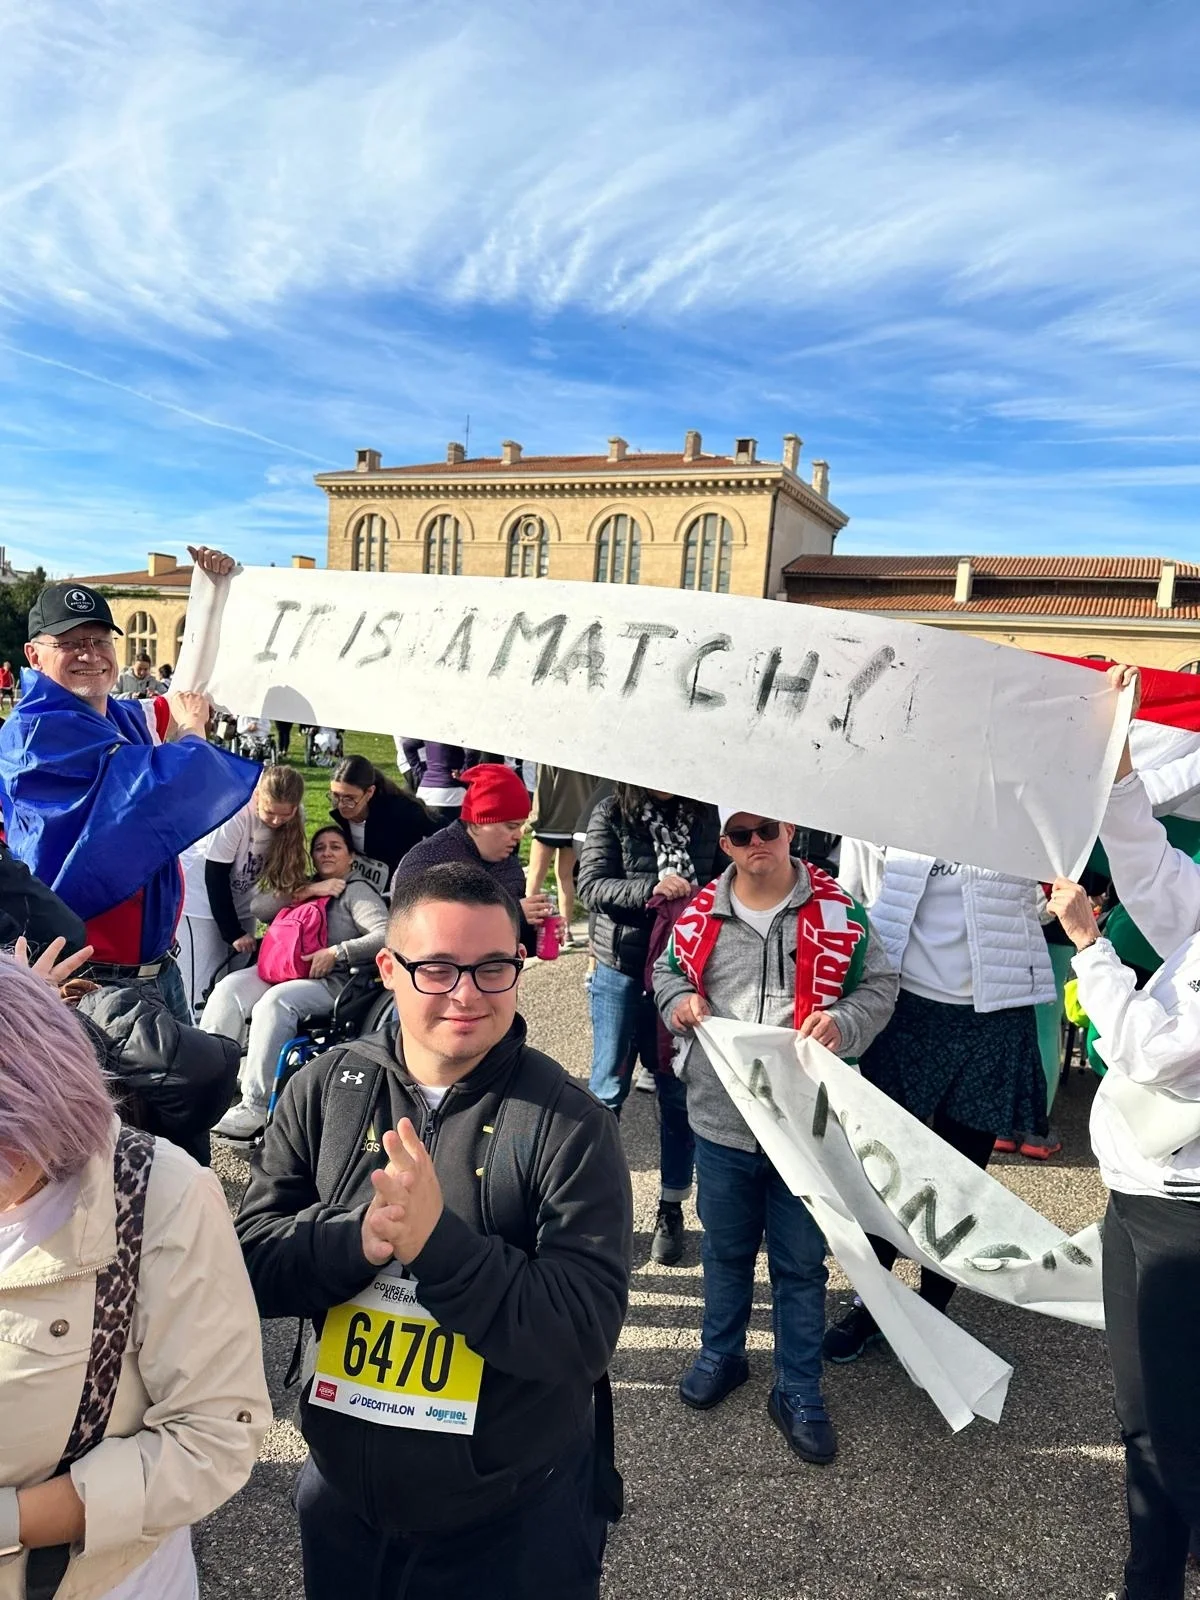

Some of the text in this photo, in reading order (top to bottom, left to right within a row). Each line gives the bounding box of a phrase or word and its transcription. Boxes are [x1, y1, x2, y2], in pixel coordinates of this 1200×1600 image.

[253, 600, 336, 662] IT
[337, 610, 404, 669] IS
[434, 606, 479, 672] A
[929, 861, 962, 877] ow
[374, 1281, 406, 1296] COURSE
[343, 1312, 455, 1393] 6470
[361, 1396, 416, 1416] DECATHLON
